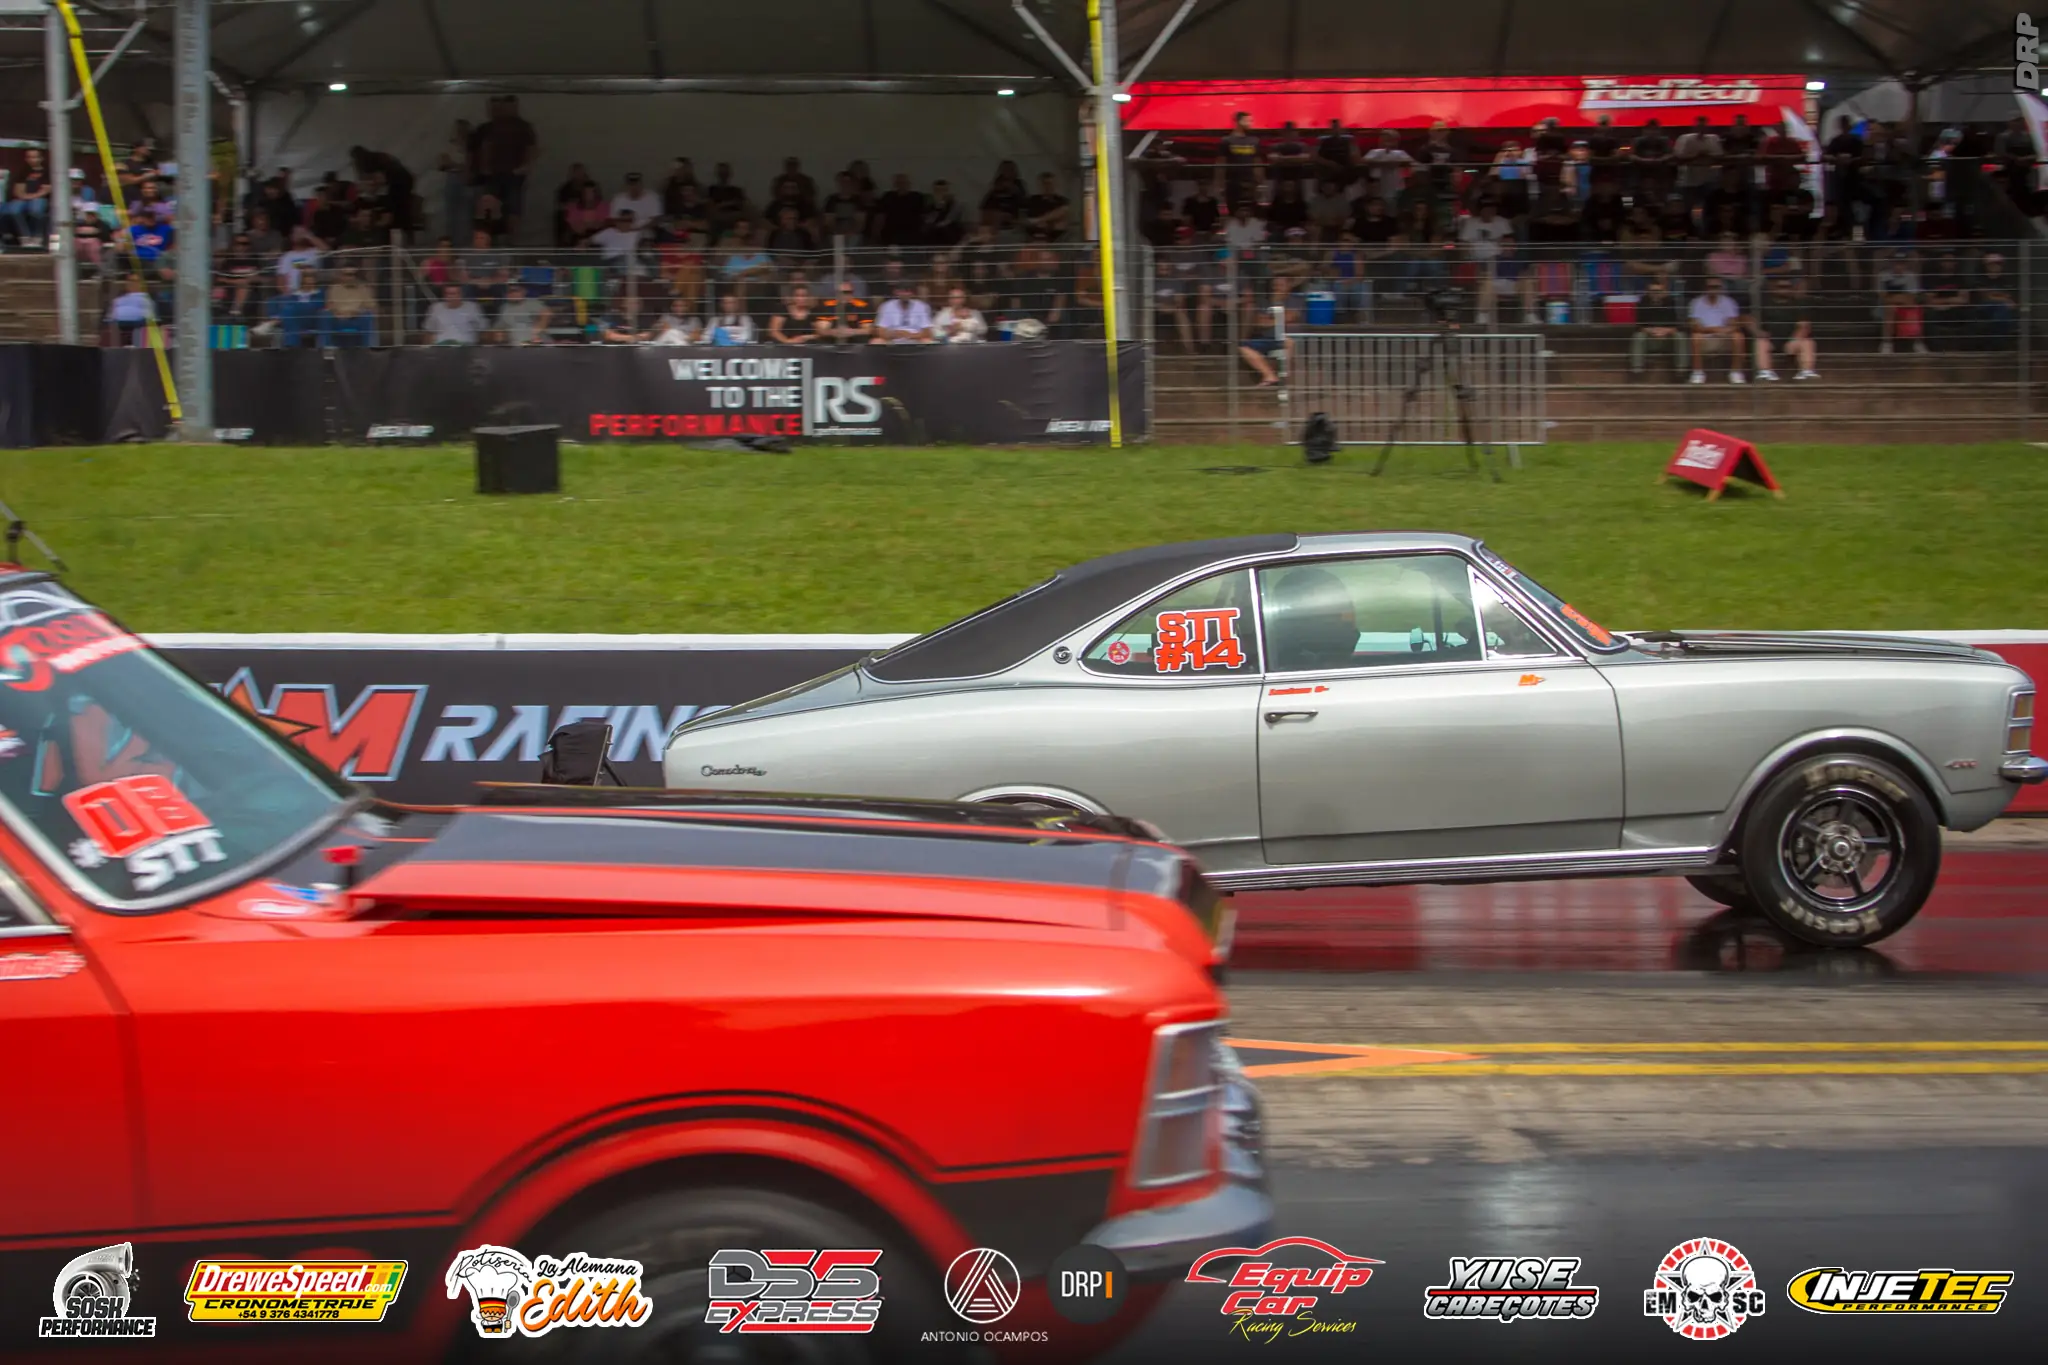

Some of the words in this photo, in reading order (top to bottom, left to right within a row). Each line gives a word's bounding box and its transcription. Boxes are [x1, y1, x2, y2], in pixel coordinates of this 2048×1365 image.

[669, 358, 801, 380] WELCOME
[706, 387, 744, 408] TO
[748, 386, 802, 407] THE
[813, 376, 886, 423] RS
[589, 414, 802, 436] PERFORMANCE
[1158, 609, 1240, 642] STT
[1156, 639, 1245, 672] #14
[126, 828, 228, 891] STT
